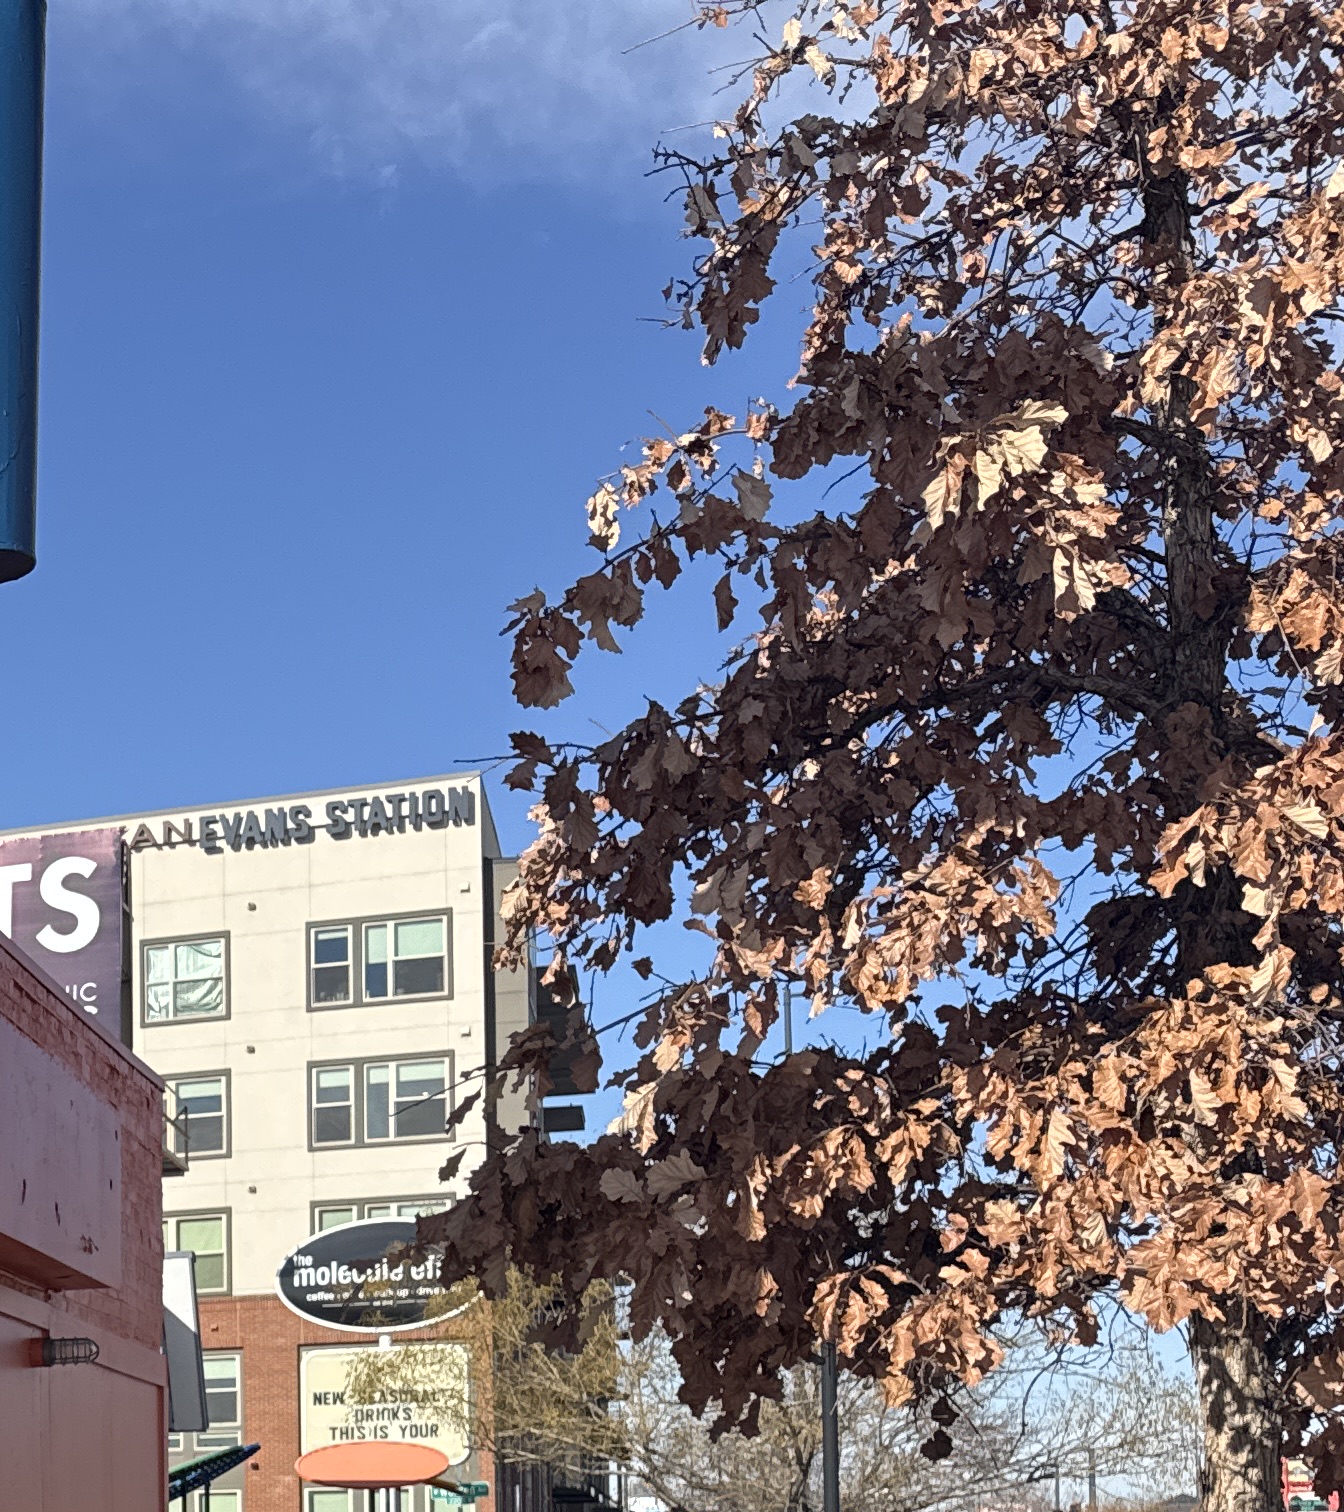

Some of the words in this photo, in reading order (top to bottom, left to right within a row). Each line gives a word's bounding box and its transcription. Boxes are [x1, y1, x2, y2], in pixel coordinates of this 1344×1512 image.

[199, 804, 314, 852] EVANS
[325, 786, 475, 838] STATION
[293, 1255, 313, 1267] the
[306, 1291, 335, 1302] coffee
[313, 1391, 344, 1405] NEW
[355, 1407, 413, 1422] DRINKS
[329, 1425, 366, 1440] THIS
[373, 1425, 389, 1439] IS
[399, 1422, 439, 1439] YOUR
